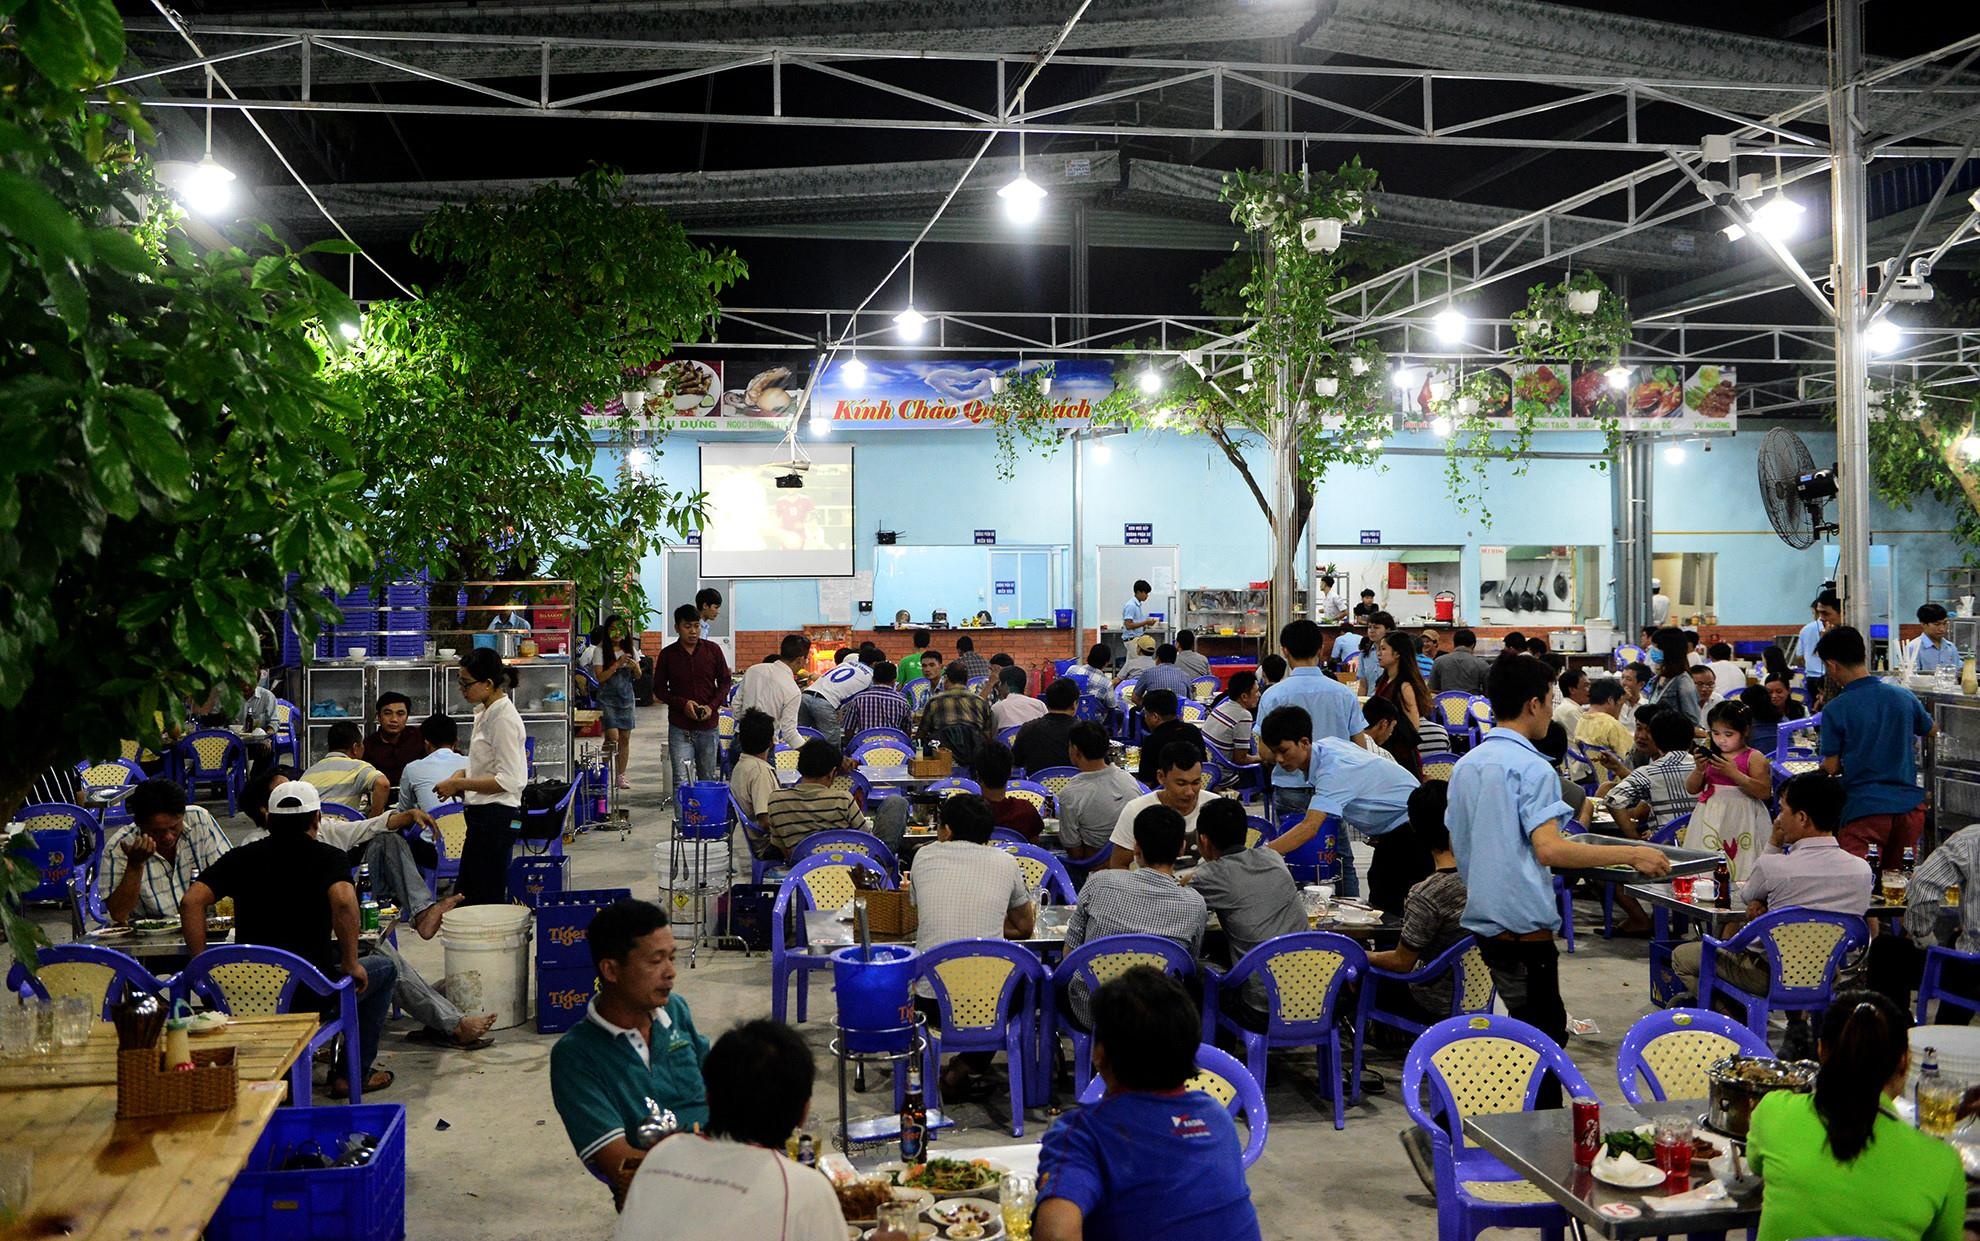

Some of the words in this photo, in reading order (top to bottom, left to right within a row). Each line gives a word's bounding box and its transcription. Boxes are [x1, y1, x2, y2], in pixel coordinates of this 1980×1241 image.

[833, 399, 893, 420] Kính
[899, 399, 958, 420] Chào
[1017, 398, 1092, 419] ách
[549, 926, 589, 946] Tiger
[549, 989, 589, 1010] Tiger
